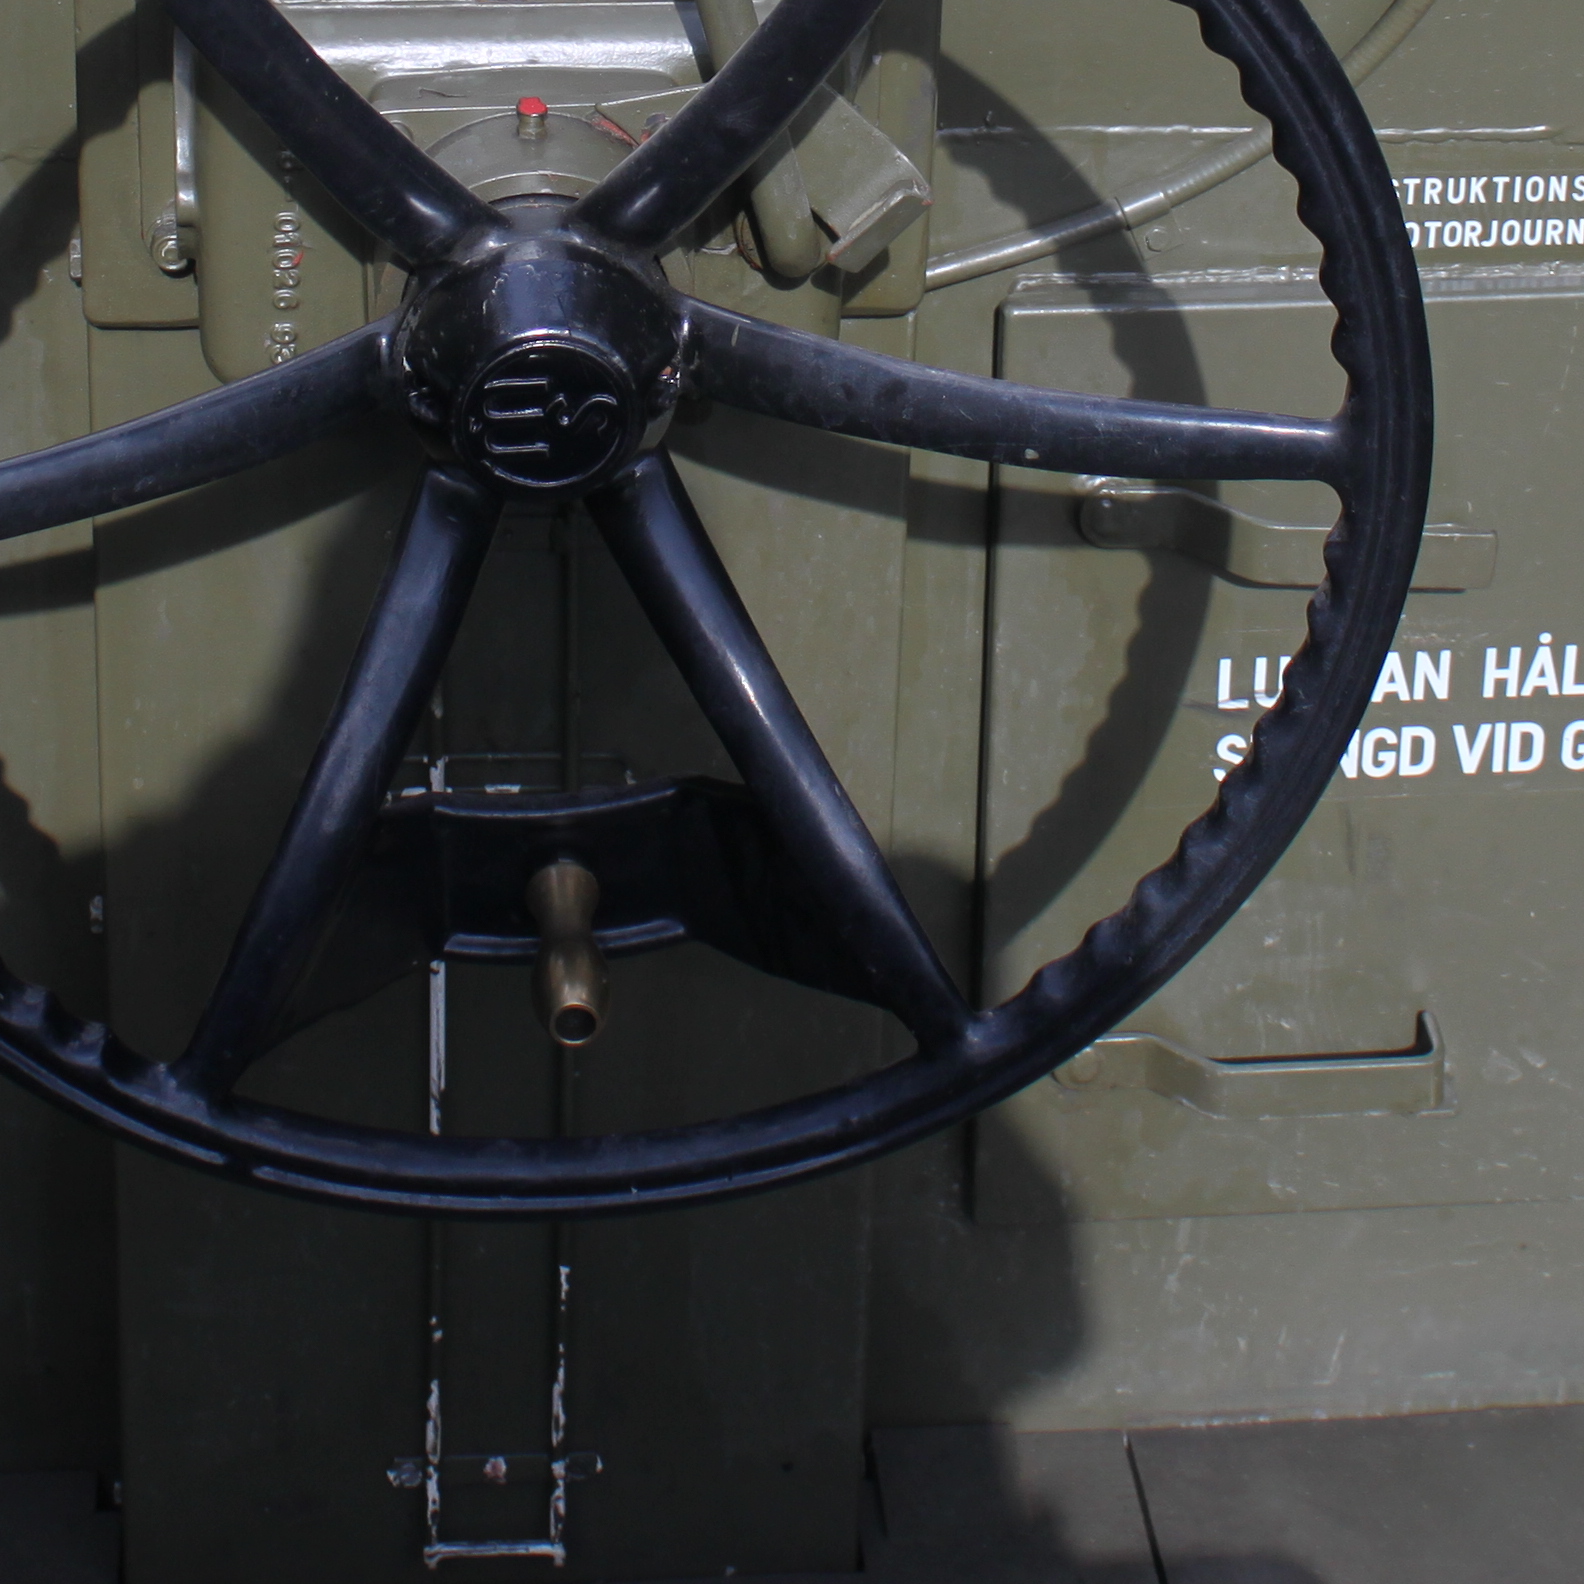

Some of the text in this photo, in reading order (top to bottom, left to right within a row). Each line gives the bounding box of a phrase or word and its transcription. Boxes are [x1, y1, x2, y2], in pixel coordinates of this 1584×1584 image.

[1218, 649, 1452, 710] LUAN
[1213, 724, 1437, 781] SNGD
[1452, 722, 1546, 775] VID
